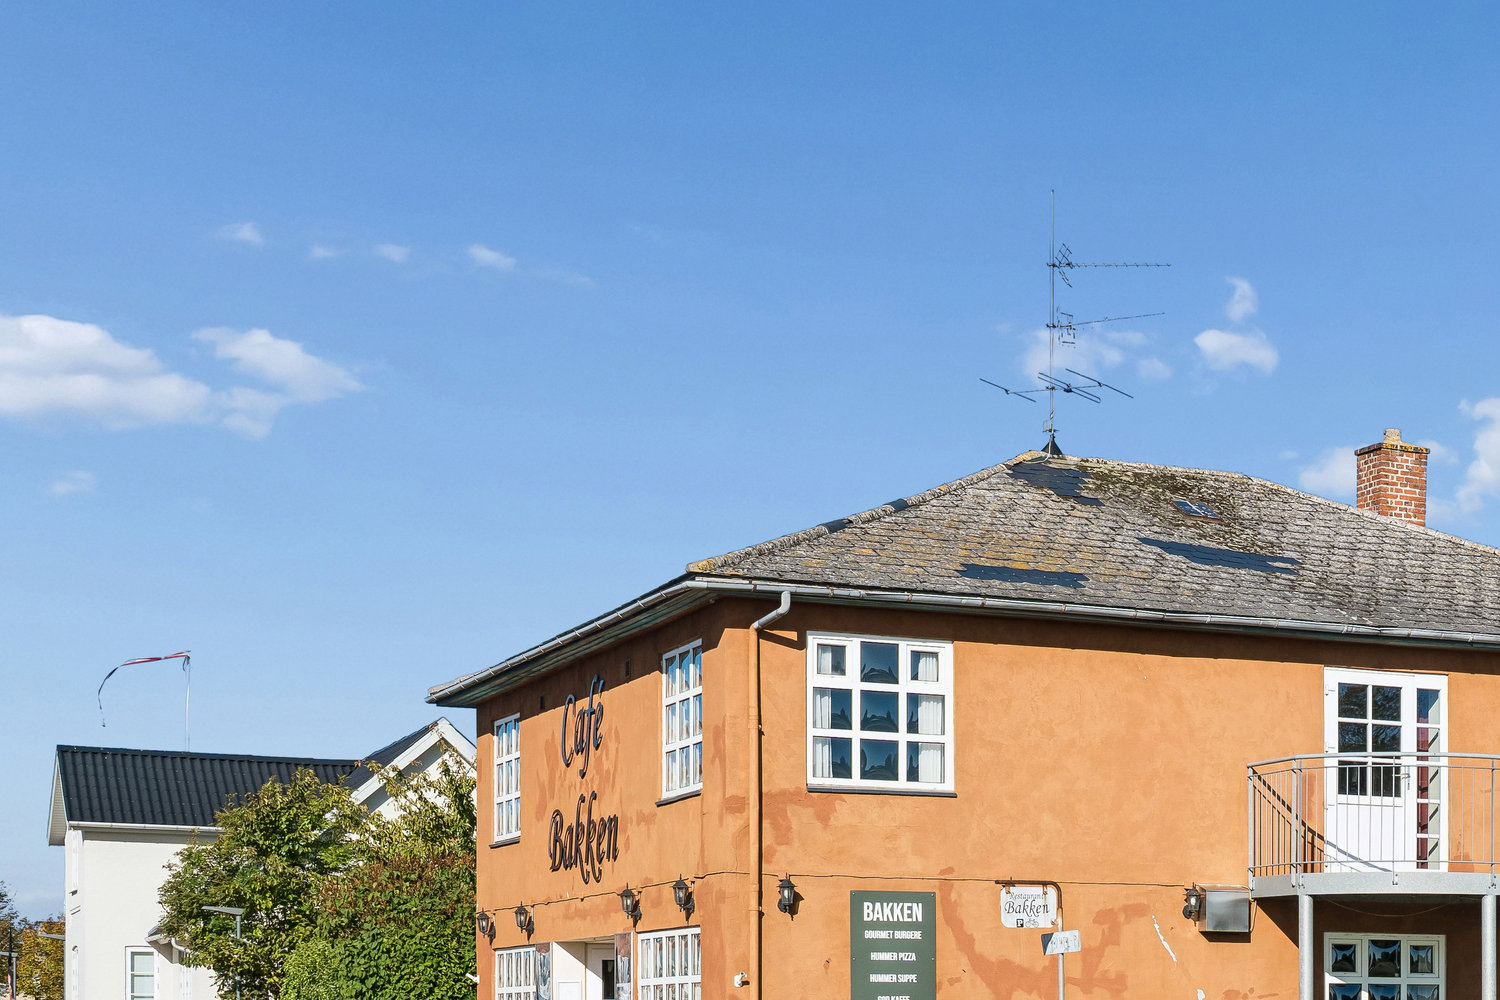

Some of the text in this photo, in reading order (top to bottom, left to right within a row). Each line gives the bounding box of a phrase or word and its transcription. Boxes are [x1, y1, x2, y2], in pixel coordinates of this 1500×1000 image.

[561, 674, 605, 779] Café
[549, 790, 620, 884] Bakken
[864, 902, 923, 922] BAKKEN
[1004, 900, 1050, 918] Bakken
[864, 930, 922, 940] GOURMET BURGERE
[870, 952, 916, 961] HUMMER PIZZA
[869, 973, 918, 983] HUMMER SUPPE
